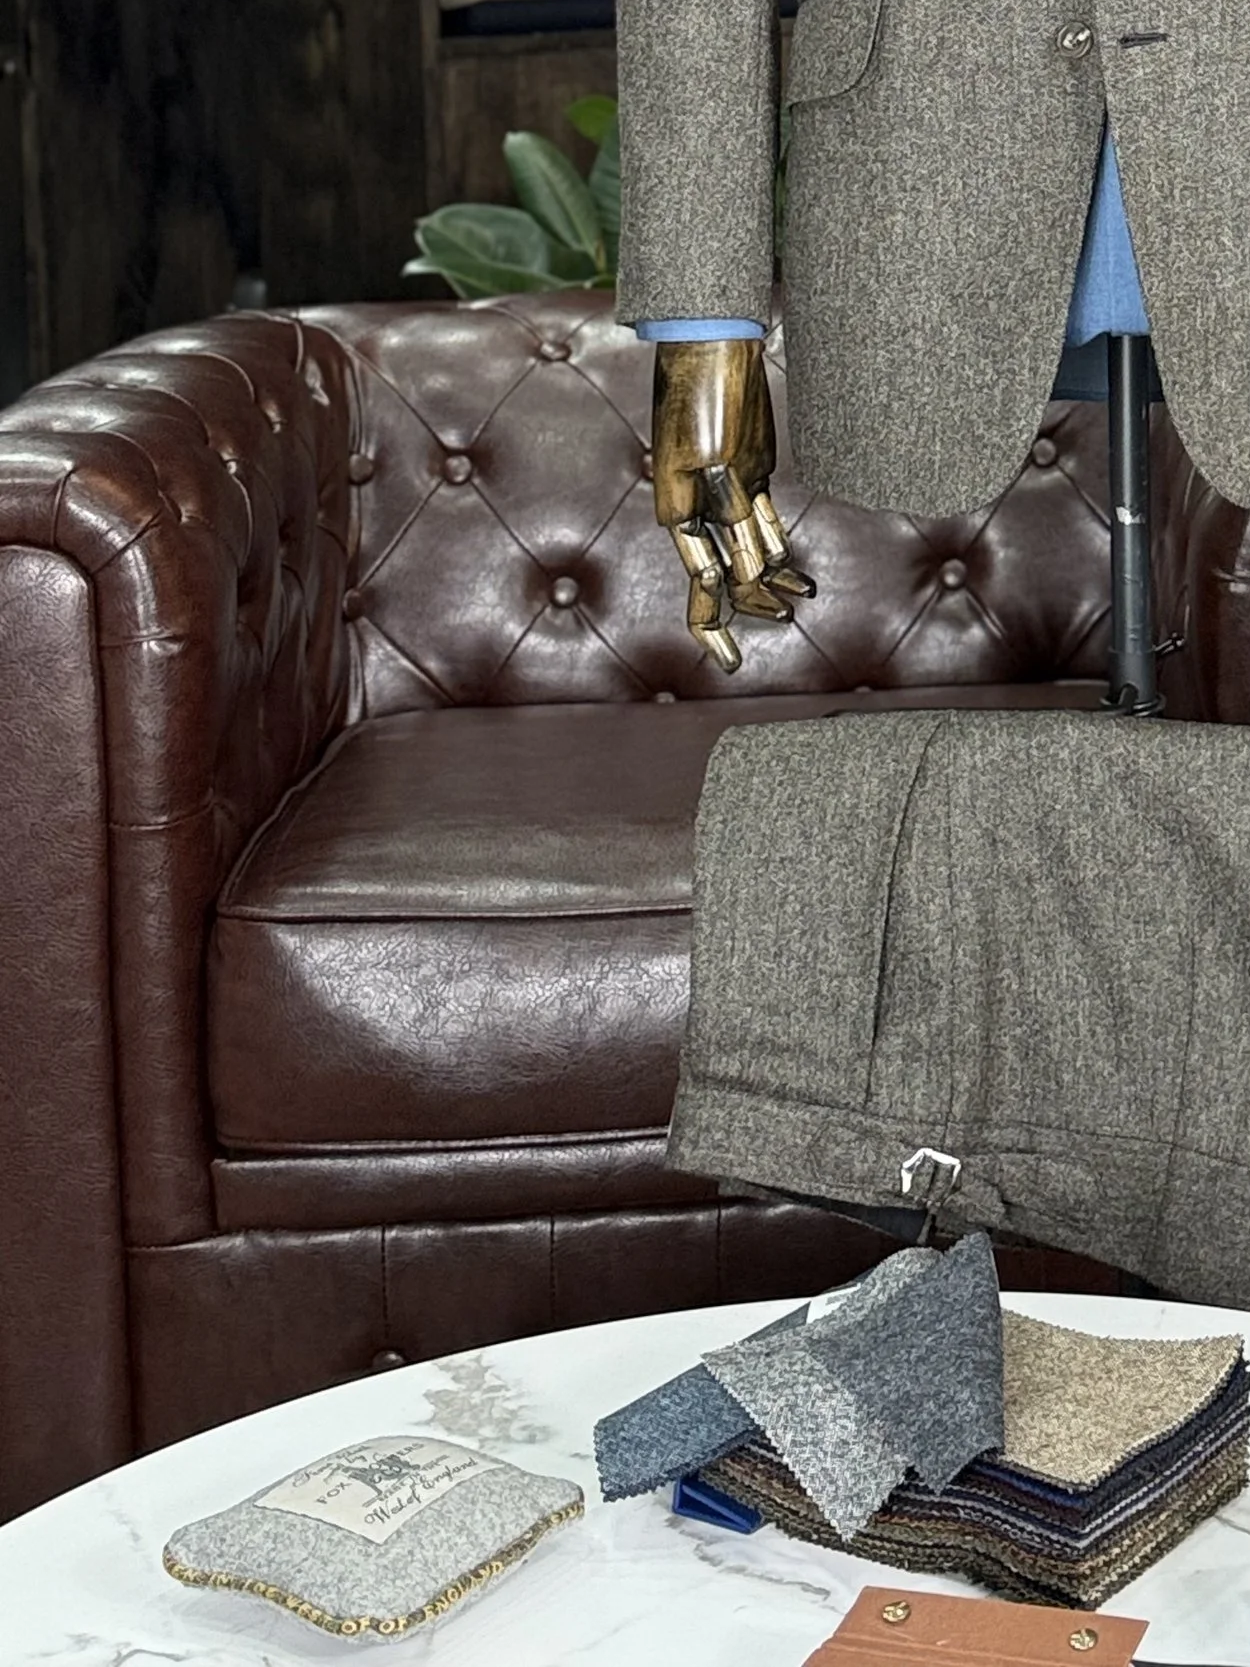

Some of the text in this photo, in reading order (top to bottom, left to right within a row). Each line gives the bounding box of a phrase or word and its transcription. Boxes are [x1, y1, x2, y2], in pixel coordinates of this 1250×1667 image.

[421, 1456, 478, 1490] England
[315, 1481, 353, 1505] FOX
[378, 1560, 505, 1636] OF ENGLAND
[340, 1616, 371, 1635] OF
